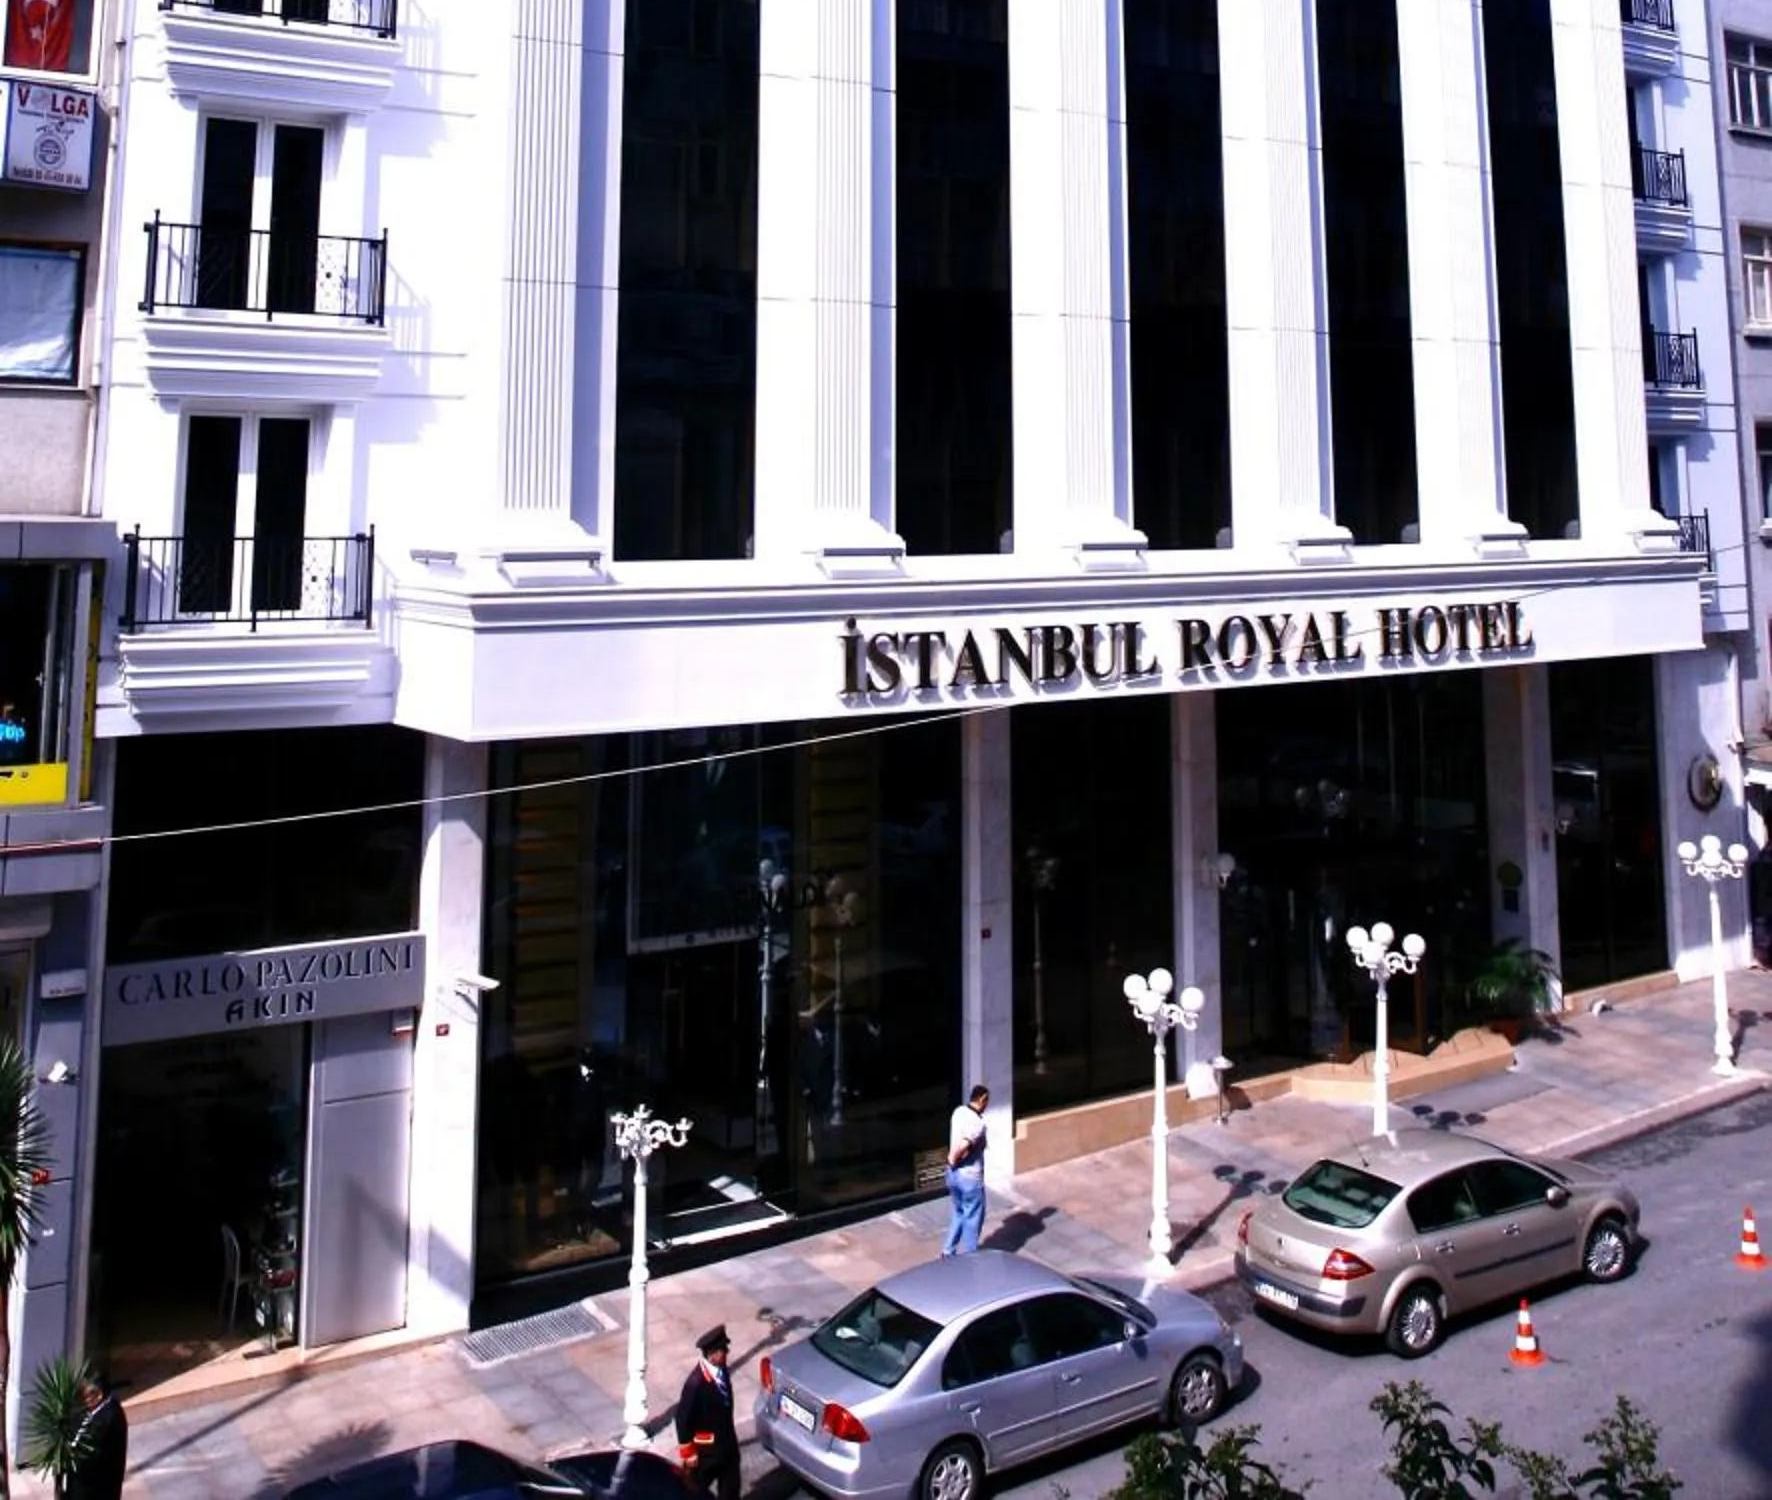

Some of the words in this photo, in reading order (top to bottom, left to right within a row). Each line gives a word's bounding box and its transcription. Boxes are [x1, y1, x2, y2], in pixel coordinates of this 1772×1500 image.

[1176, 610, 1363, 673] ROYAL
[1377, 600, 1534, 658] HOTEL
[118, 962, 245, 1006] CARLO
[256, 944, 415, 991] PAZOLINI
[225, 990, 317, 1025] AKIN
